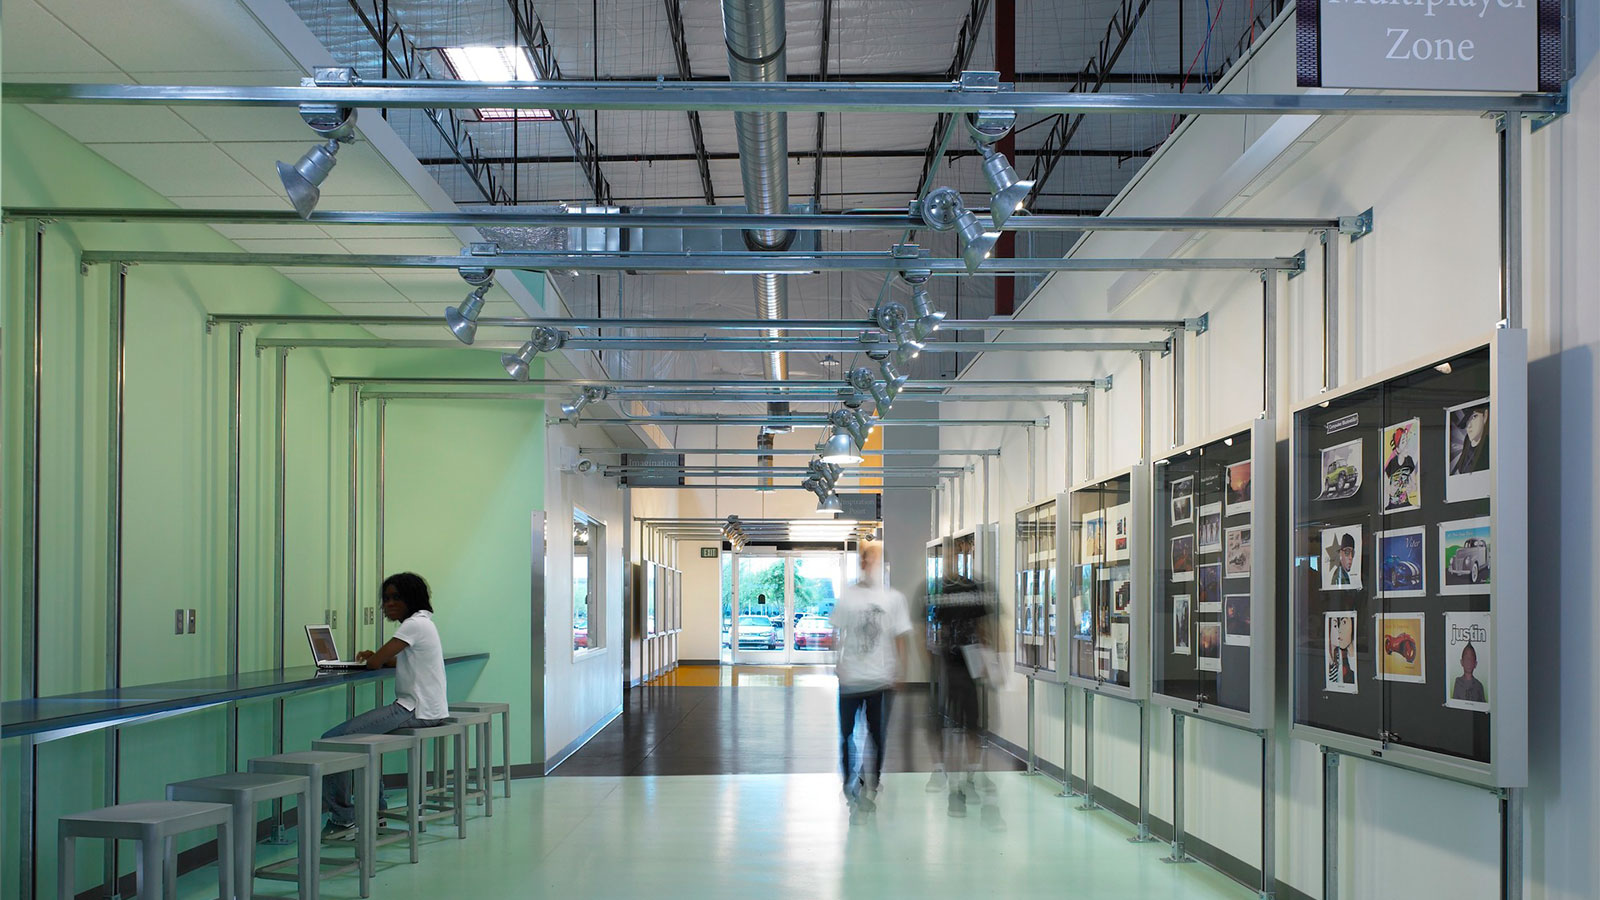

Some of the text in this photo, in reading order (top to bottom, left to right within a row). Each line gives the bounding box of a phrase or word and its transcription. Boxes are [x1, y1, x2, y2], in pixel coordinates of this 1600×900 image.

[1385, 27, 1475, 61] Zone
[629, 458, 677, 467] Imagination
[703, 548, 717, 557] EXIT
[1450, 623, 1487, 645] justin
